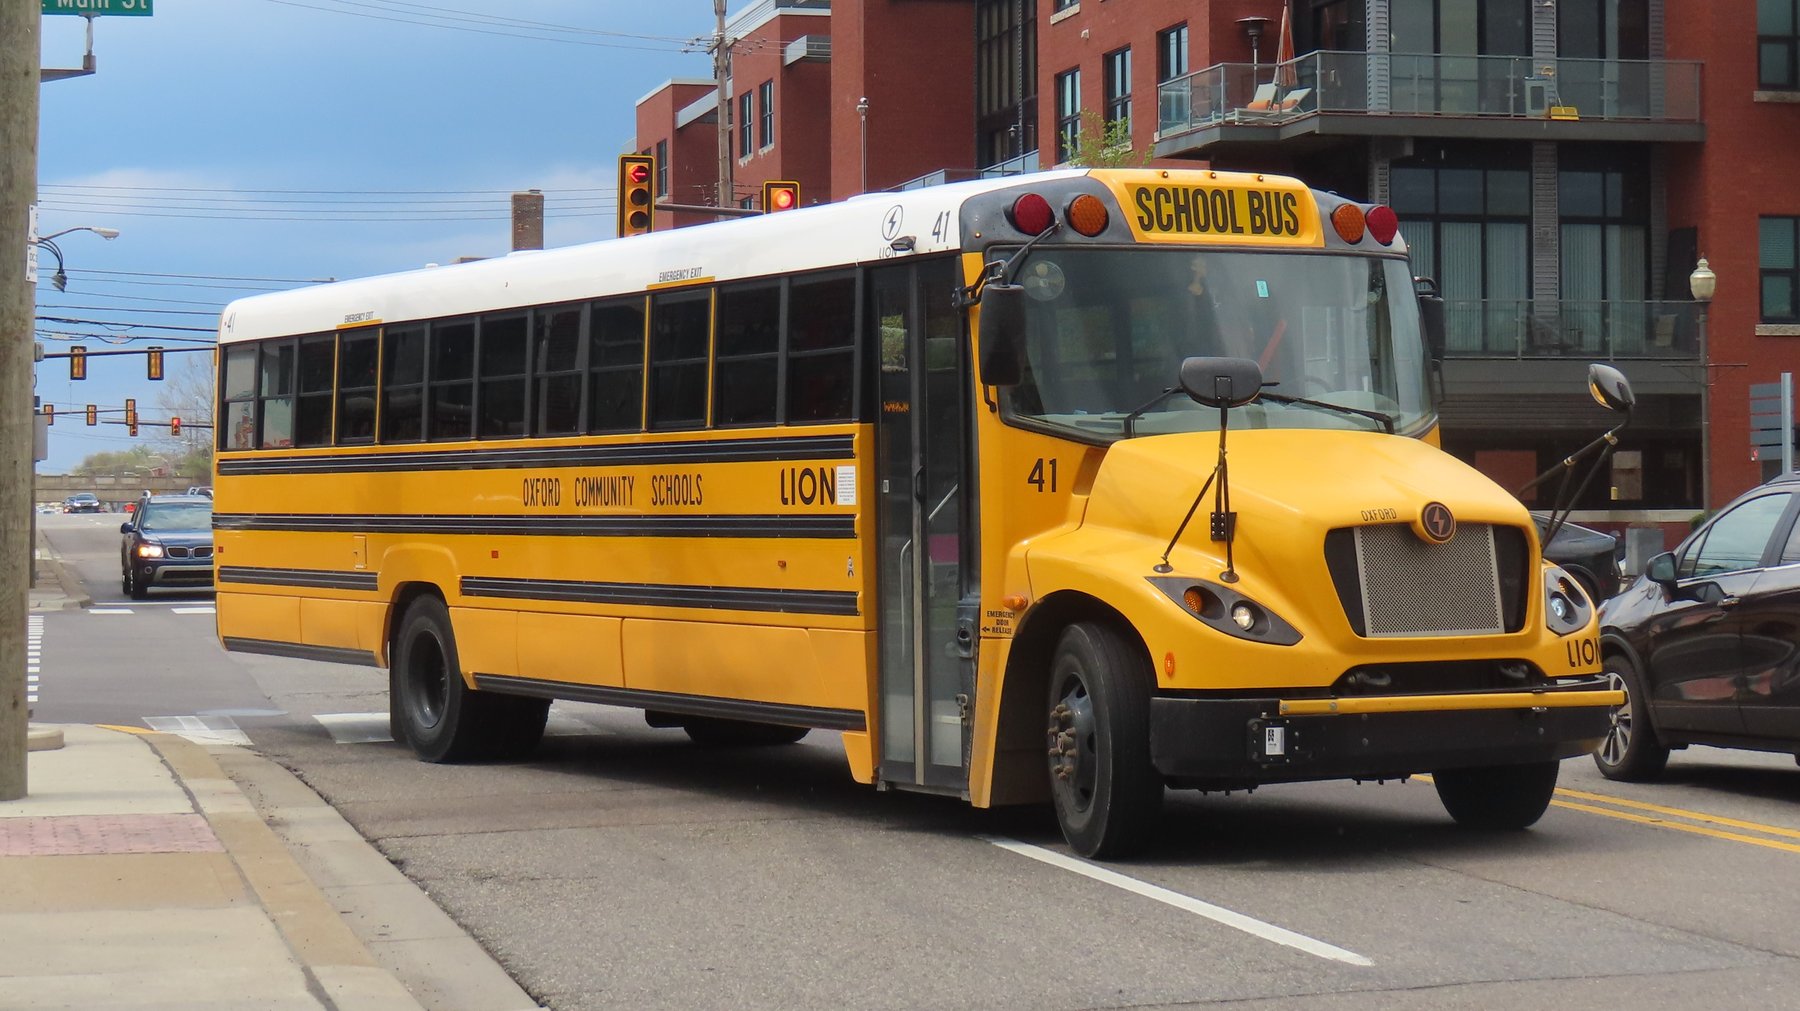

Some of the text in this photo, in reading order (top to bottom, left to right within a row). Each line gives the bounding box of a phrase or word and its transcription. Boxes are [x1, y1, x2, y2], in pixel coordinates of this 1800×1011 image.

[1136, 187, 1299, 236] SCHOOL BUS
[932, 210, 950, 243] 41
[659, 267, 702, 282] EMERGENCY EXIT
[227, 312, 236, 333] 41
[344, 311, 374, 323] EMERGENCY EXIT
[780, 467, 836, 506] LION
[1027, 458, 1057, 493] 41
[523, 474, 703, 507] OXFORD COMMUNITY SCHOOLS
[1361, 508, 1397, 521] OXFORD
[986, 610, 1015, 618] EMERGENCY
